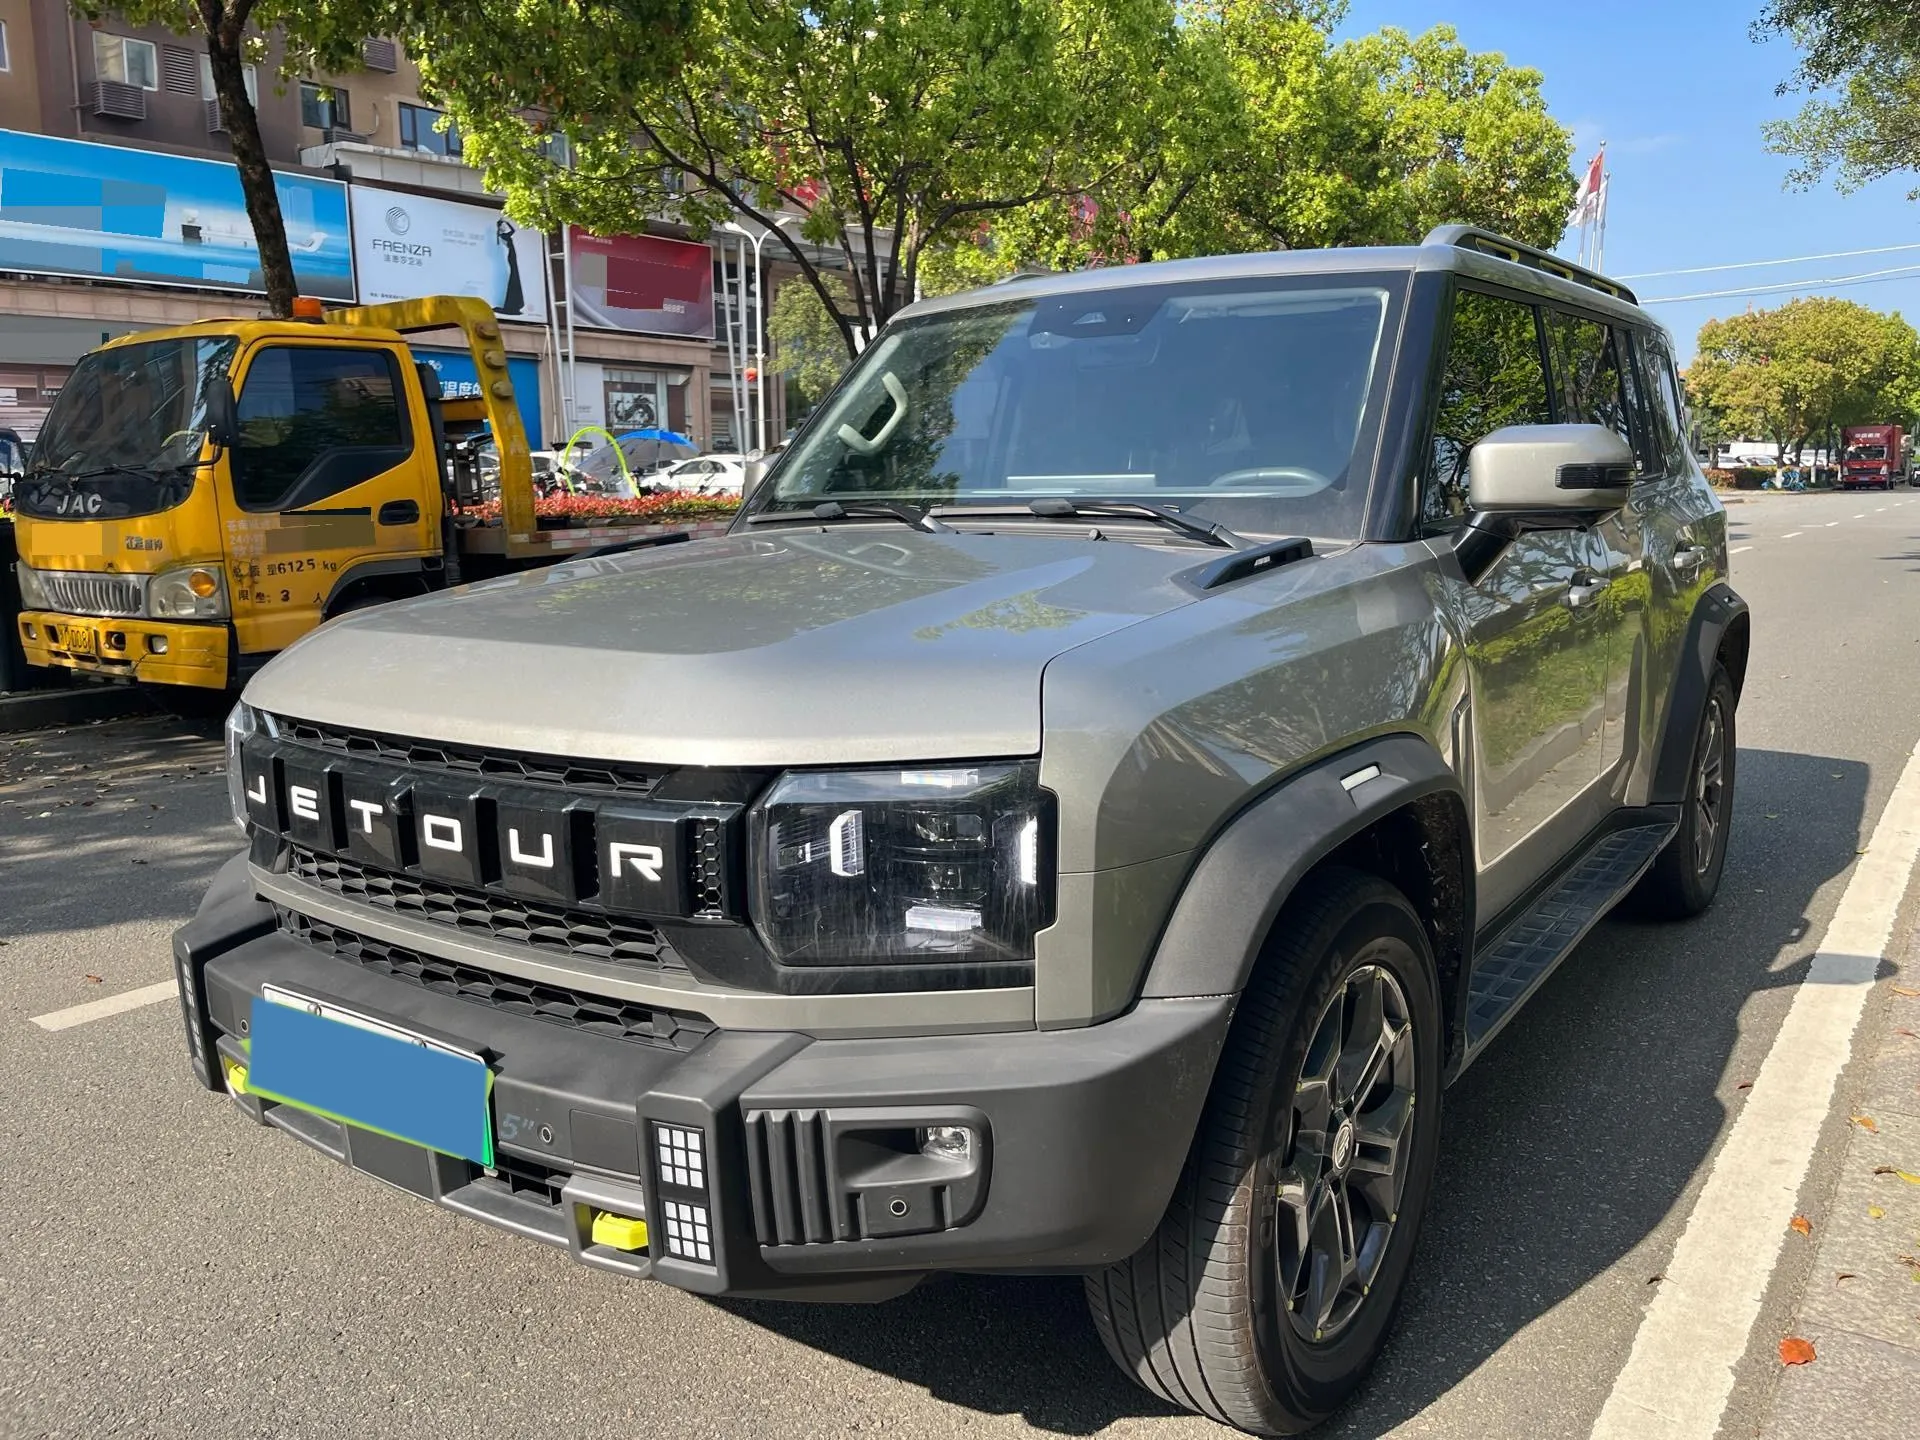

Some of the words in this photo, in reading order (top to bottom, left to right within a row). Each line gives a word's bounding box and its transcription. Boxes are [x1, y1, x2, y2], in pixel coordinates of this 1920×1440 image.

[57, 494, 102, 514] JAC
[277, 558, 316, 575] 6125
[322, 560, 338, 573] kg
[281, 589, 290, 602] 3
[247, 775, 663, 882] JETOUR
